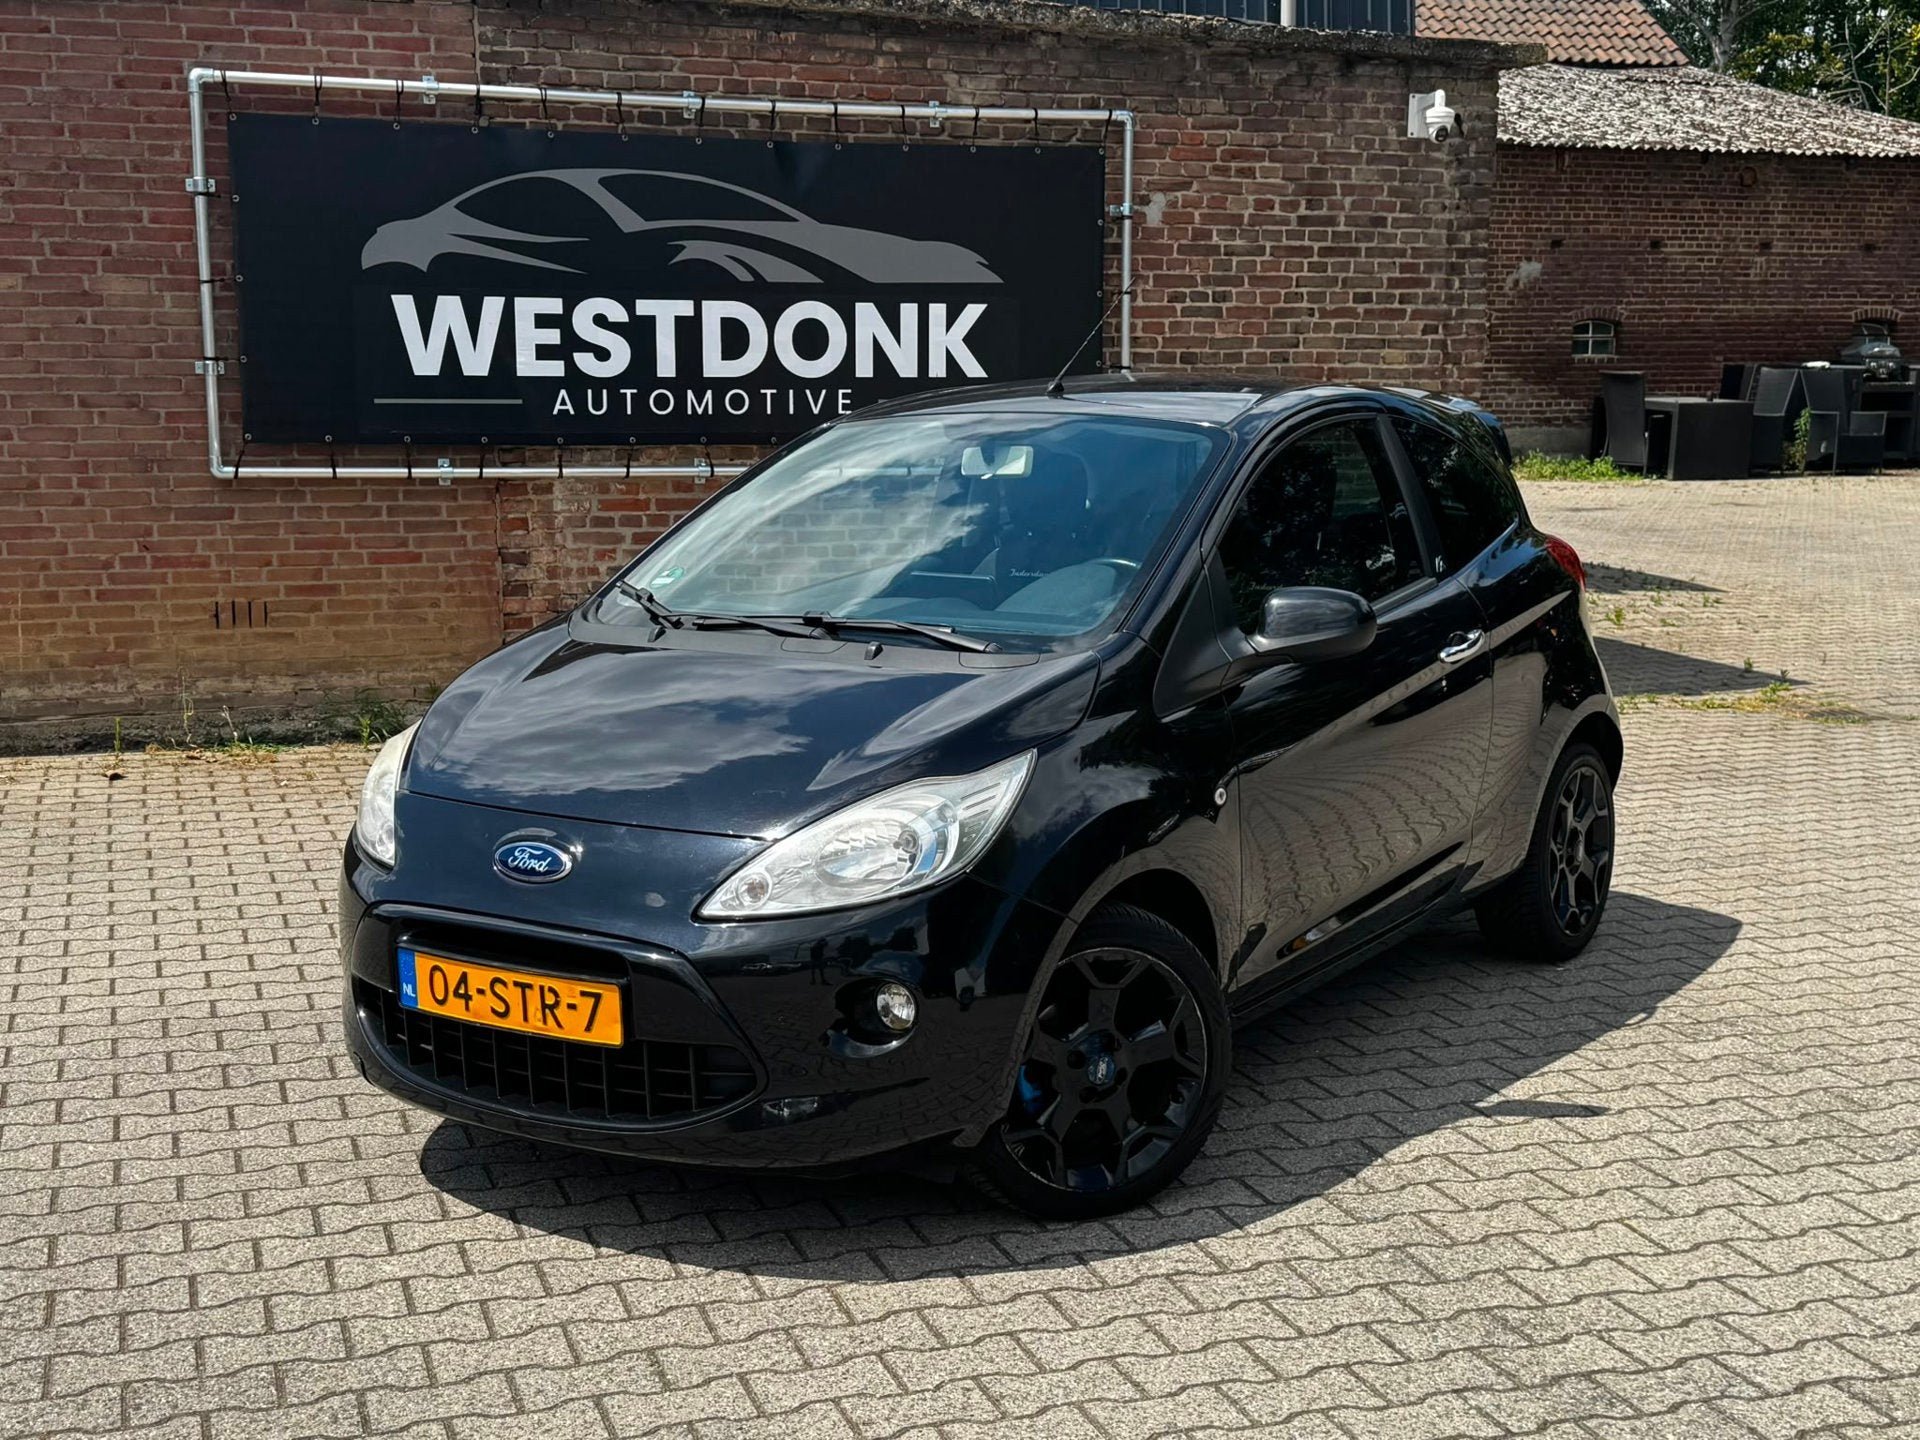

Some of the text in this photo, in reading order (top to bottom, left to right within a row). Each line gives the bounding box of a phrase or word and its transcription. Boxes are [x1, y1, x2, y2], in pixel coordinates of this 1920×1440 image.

[390, 294, 989, 379] WESTDONK
[552, 388, 853, 416] AUTOMOTIVE
[508, 846, 552, 873] Ford
[402, 982, 416, 997] NL
[428, 964, 604, 1033] 04-STR-7
